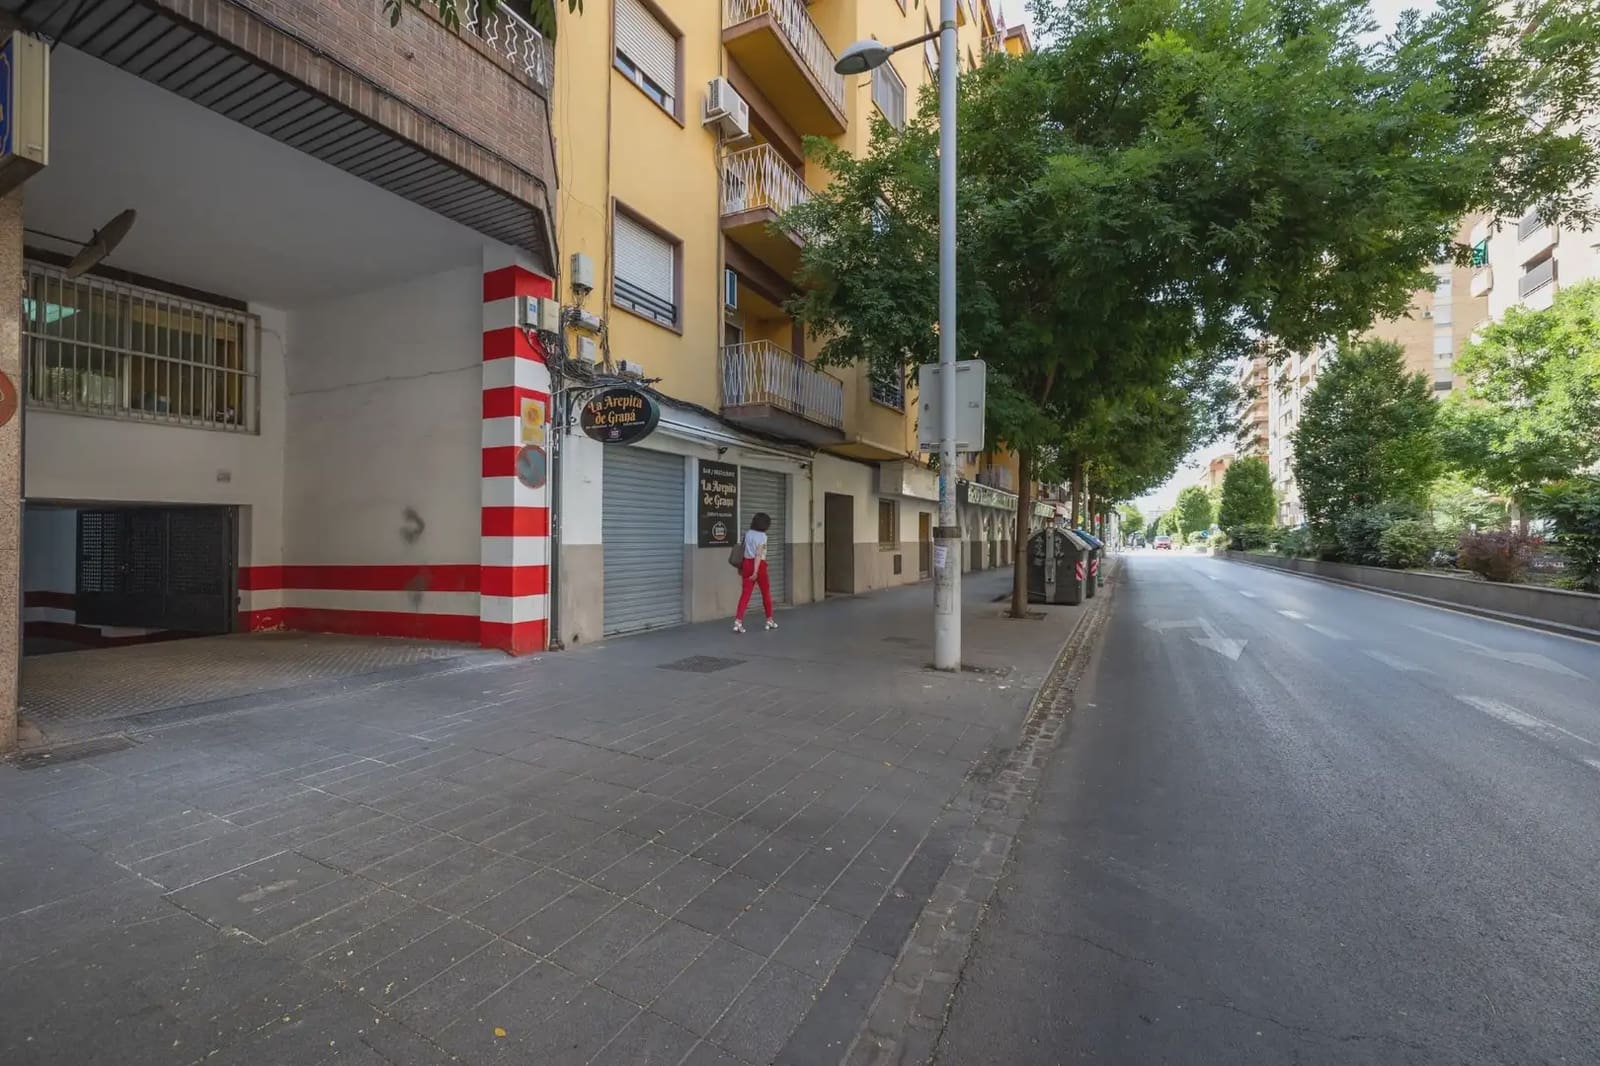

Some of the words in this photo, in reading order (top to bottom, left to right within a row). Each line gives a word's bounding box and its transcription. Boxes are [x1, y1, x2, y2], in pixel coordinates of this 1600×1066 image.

[588, 401, 603, 413] La
[604, 395, 642, 410] Arepita
[595, 412, 606, 424] de
[608, 409, 636, 426] Graná
[701, 480, 711, 491] La
[704, 493, 713, 505] de
